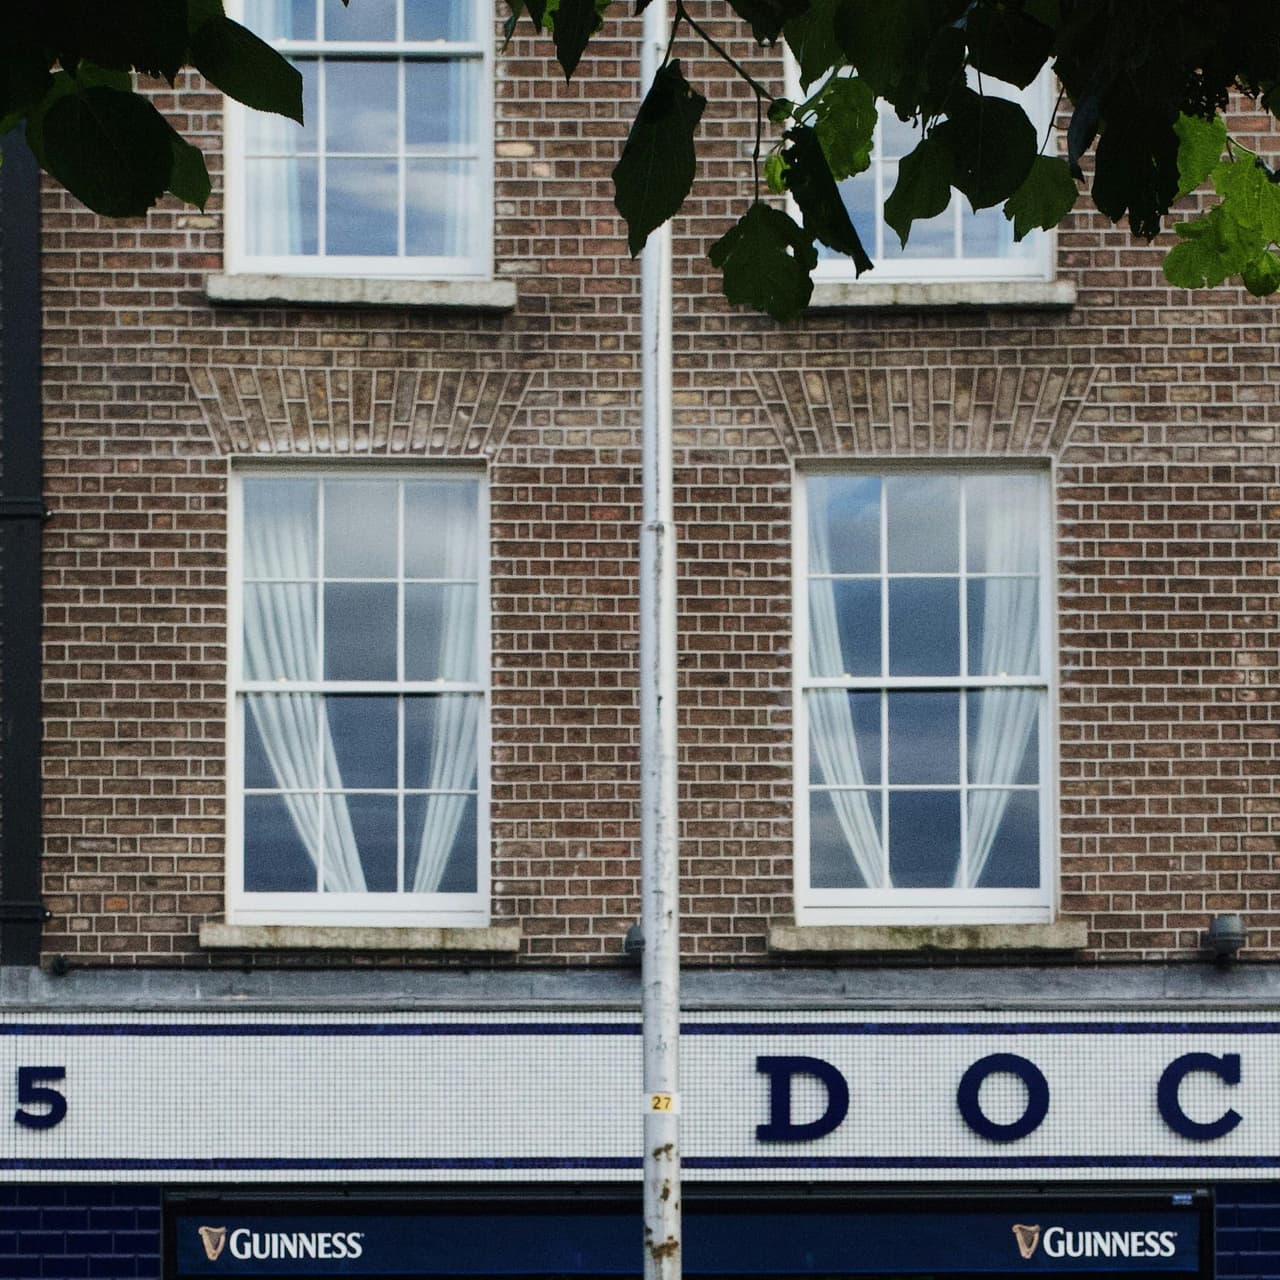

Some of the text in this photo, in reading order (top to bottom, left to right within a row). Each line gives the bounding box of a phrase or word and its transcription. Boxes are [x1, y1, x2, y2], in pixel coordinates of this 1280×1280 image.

[14, 1066, 68, 1130] 5
[652, 1096, 671, 1110] 27
[229, 1228, 363, 1259] GUINNESS
[1043, 1226, 1176, 1257] GUINNESS
